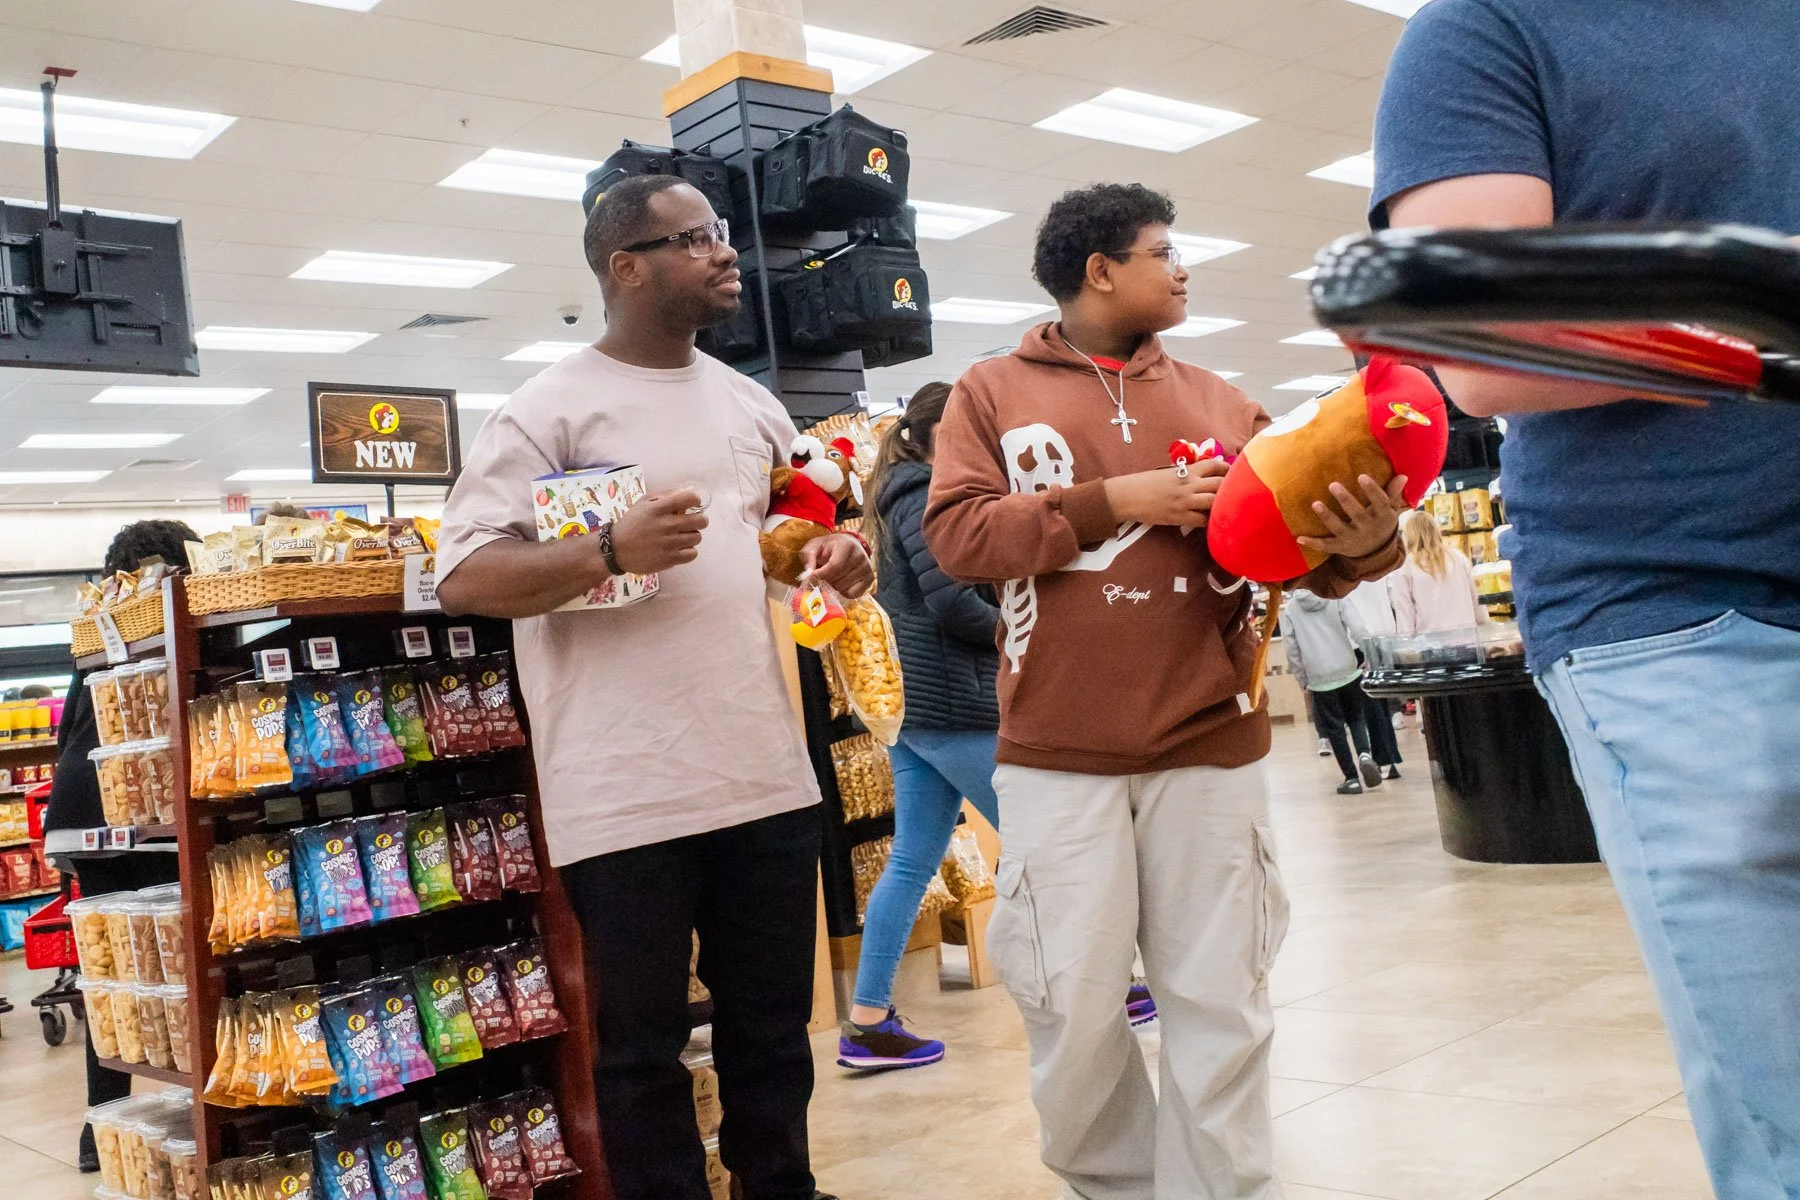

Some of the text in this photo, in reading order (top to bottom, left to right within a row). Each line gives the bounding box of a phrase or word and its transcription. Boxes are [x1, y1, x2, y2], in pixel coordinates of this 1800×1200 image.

[354, 440, 417, 468] NEW
[227, 496, 247, 512] EXIT
[1103, 584, 1152, 605] E-dept
